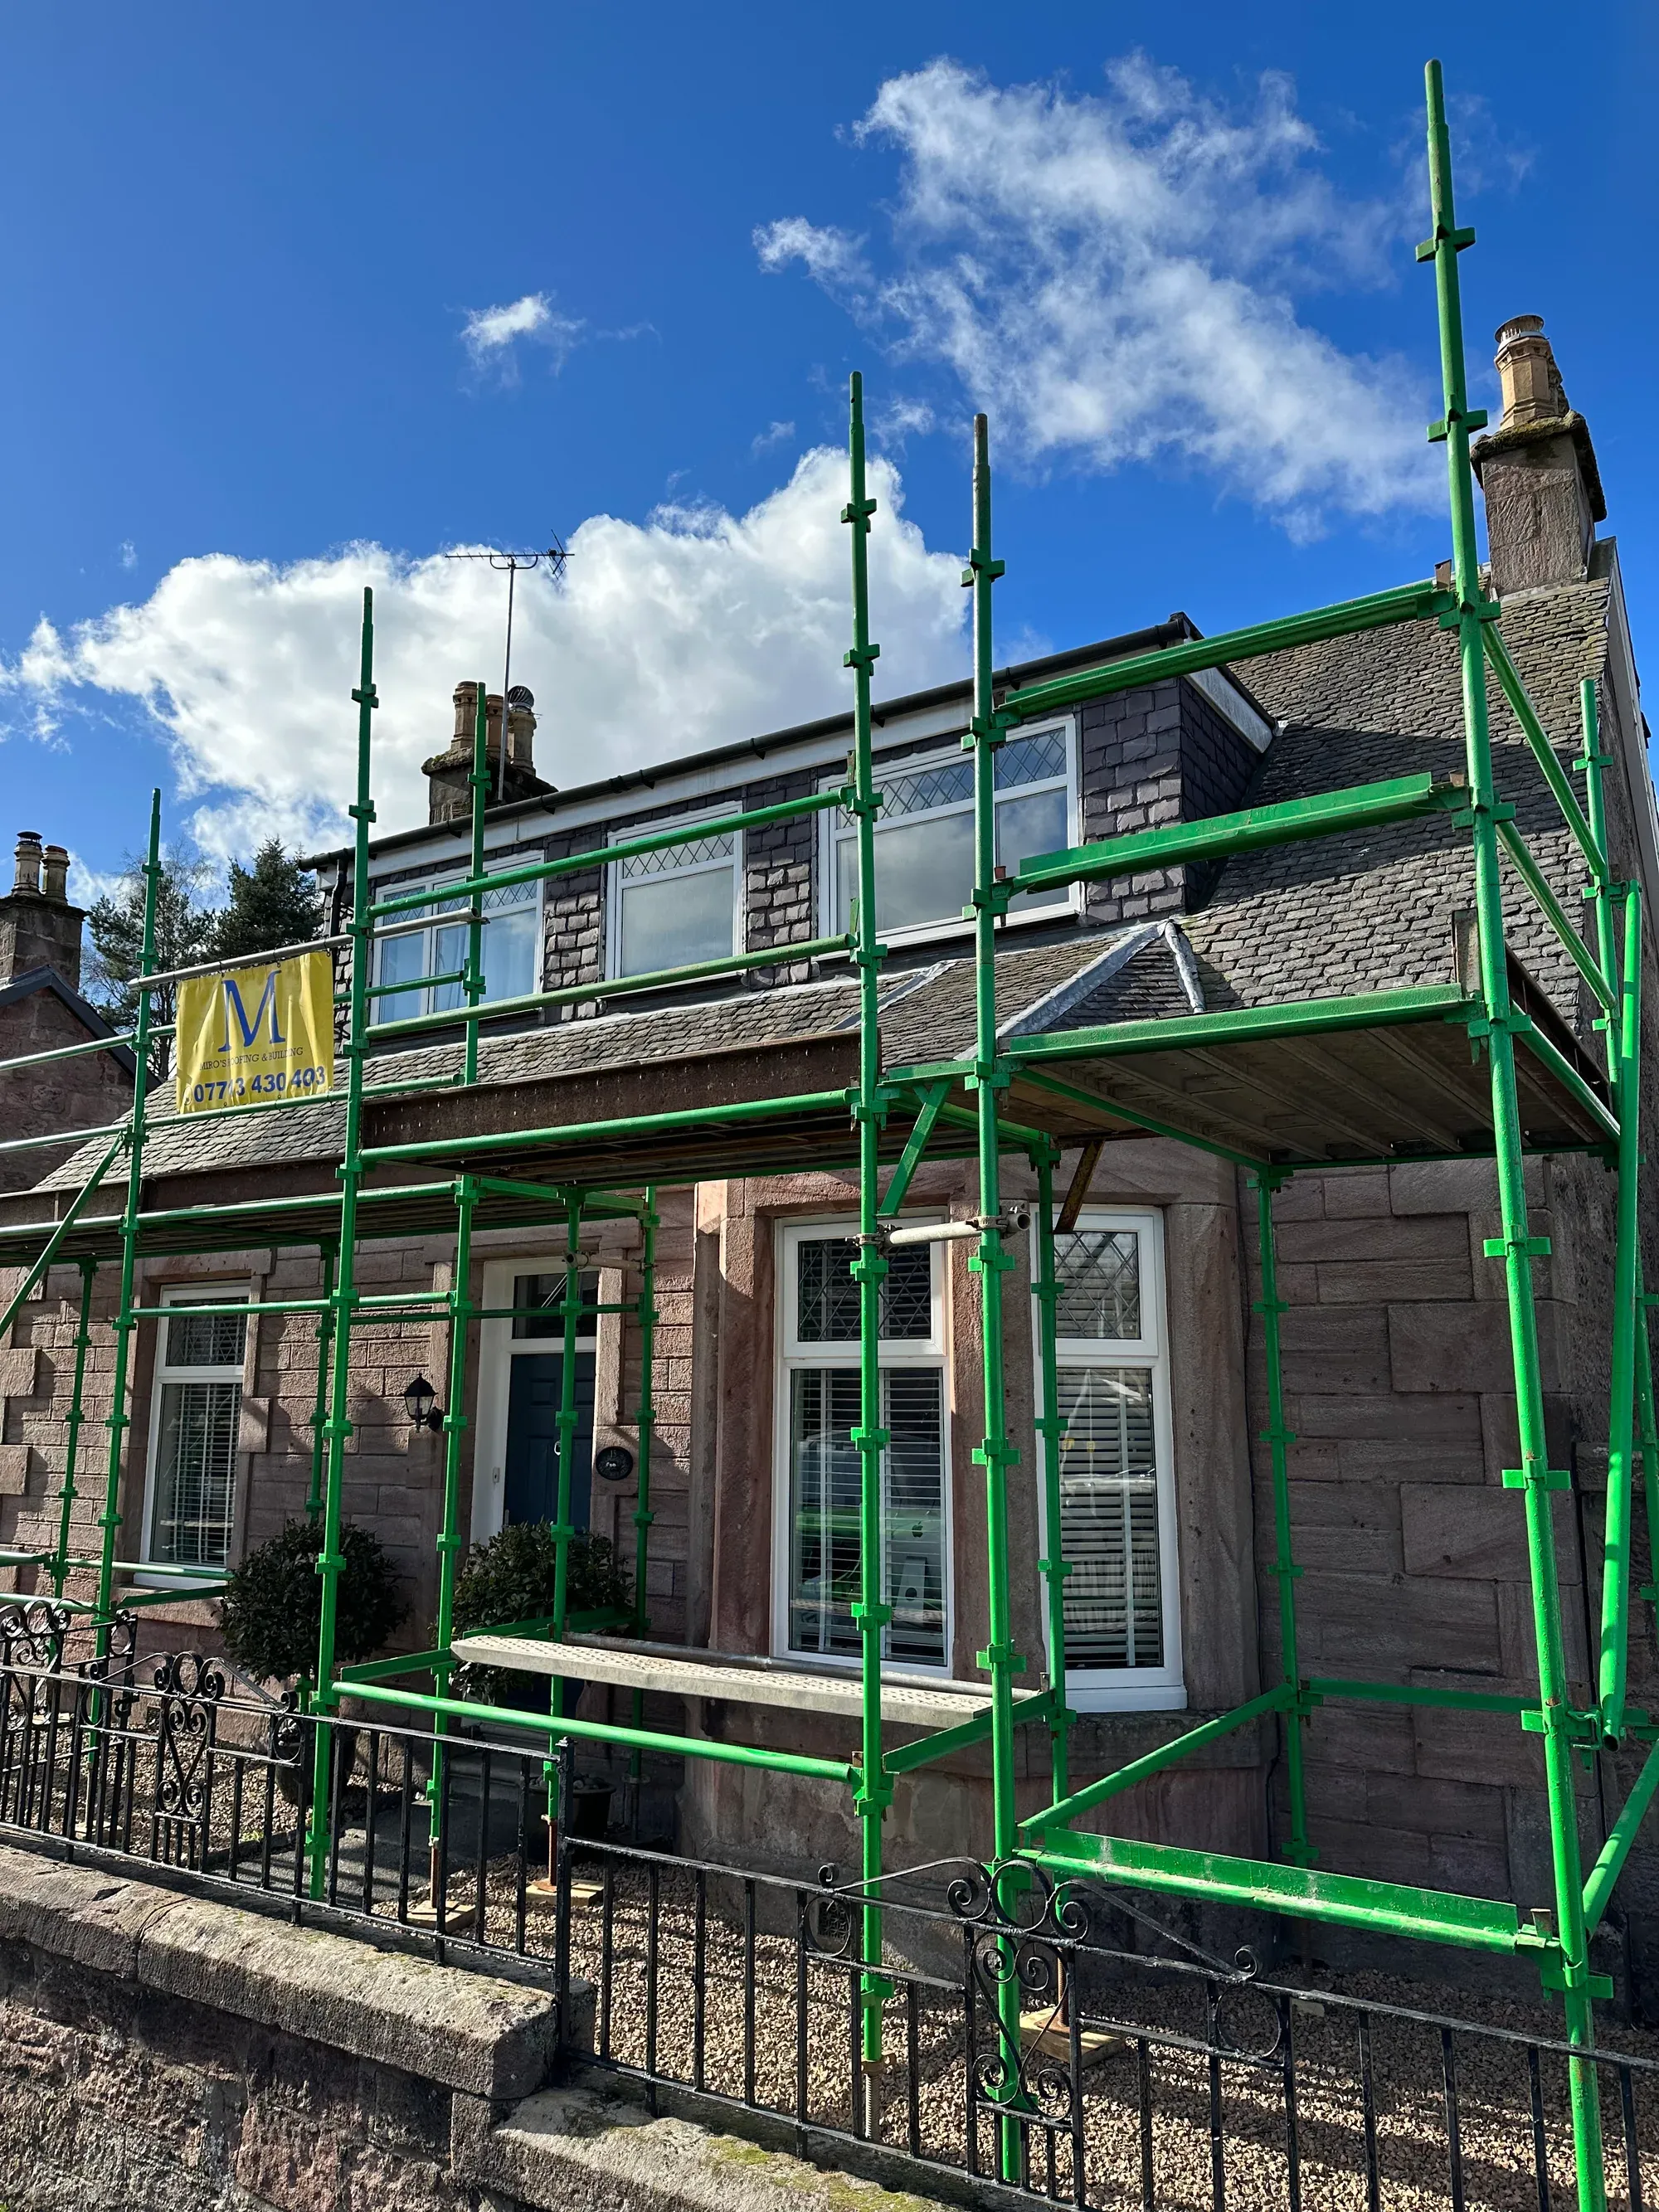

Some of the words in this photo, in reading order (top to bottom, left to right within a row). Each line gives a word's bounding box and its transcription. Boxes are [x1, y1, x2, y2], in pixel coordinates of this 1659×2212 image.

[217, 970, 286, 1053] M
[199, 1059, 226, 1071] MIRO'S
[261, 1053, 268, 1062] &
[269, 1047, 304, 1060] BUILNG
[251, 1072, 286, 1094] 430
[290, 1066, 325, 1087] 403
